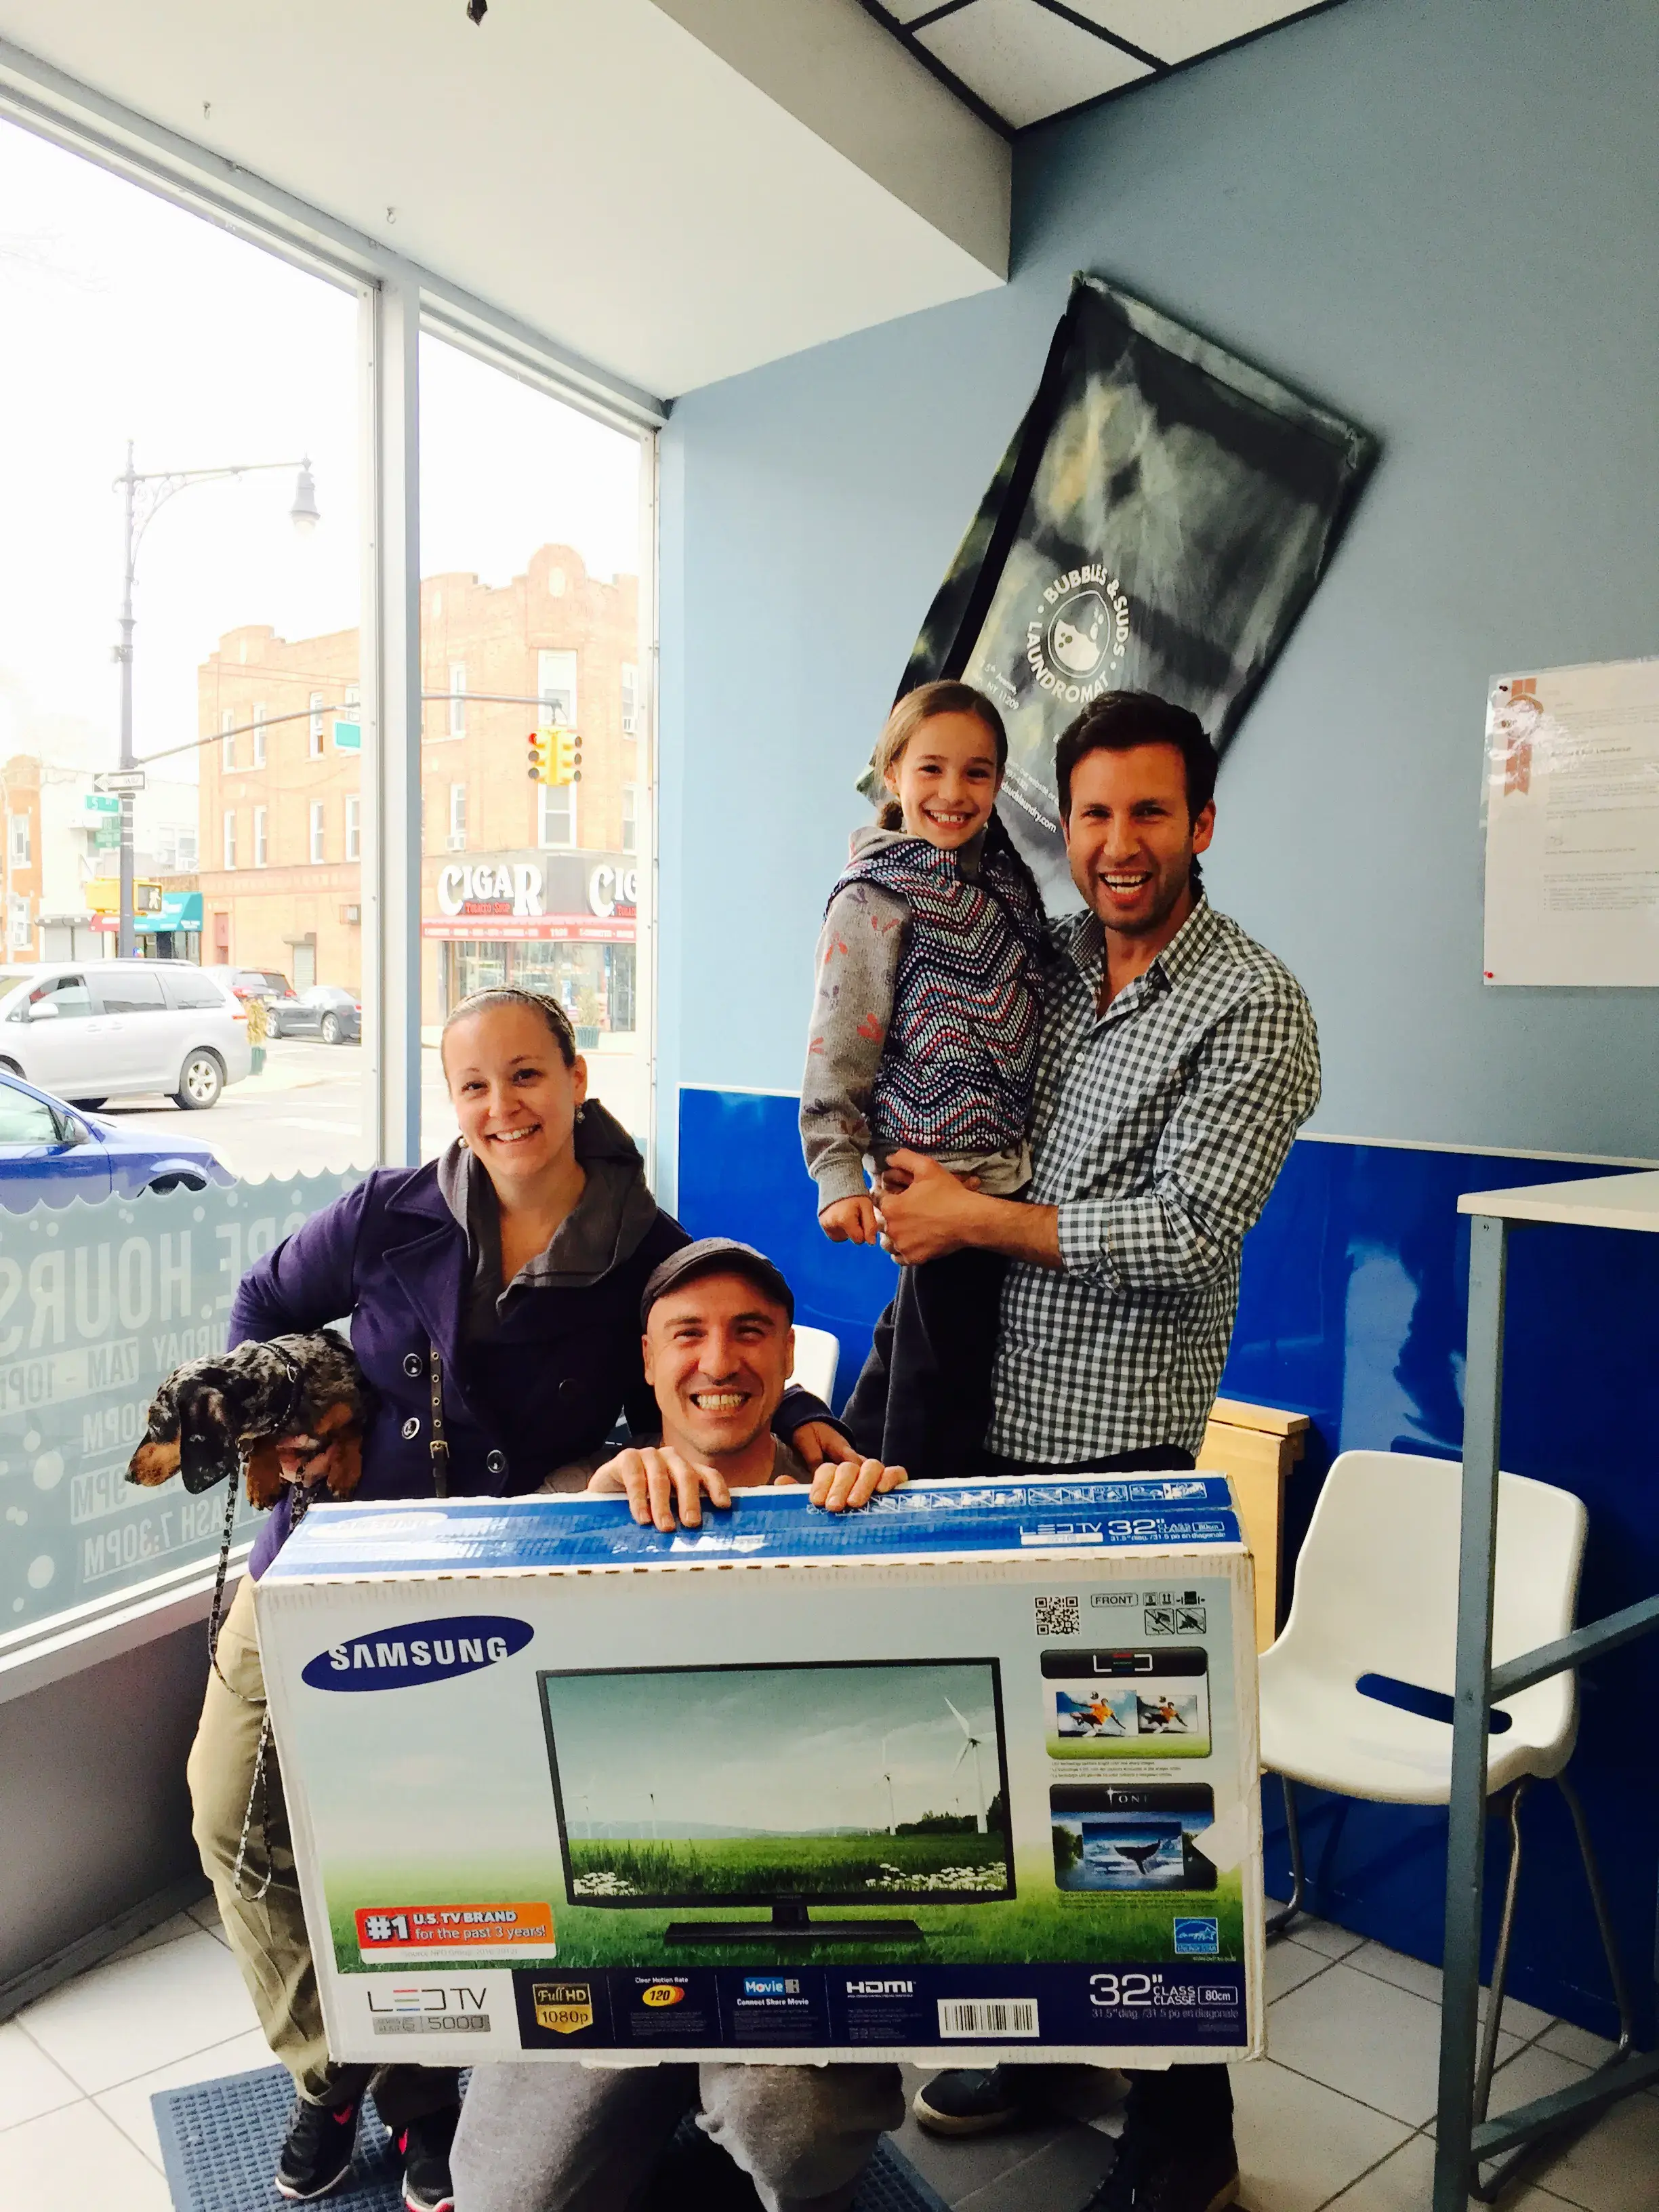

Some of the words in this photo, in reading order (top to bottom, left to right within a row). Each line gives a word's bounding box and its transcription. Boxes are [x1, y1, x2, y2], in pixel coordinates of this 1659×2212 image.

[1042, 564, 1108, 605] BUBBLES
[1106, 579, 1120, 601] &
[1113, 595, 1130, 657] SUDS
[1026, 621, 1109, 703] LAUNDROMAT
[987, 681, 998, 695] NY
[437, 863, 543, 917] CIGAR
[1076, 1521, 1103, 1533] TV
[1107, 1518, 1165, 1536] 32"
[1095, 1595, 1134, 1605] FRONT
[328, 1636, 509, 1671] SAMSUNG
[365, 1914, 410, 1942] #1
[441, 1912, 462, 1924] TV
[461, 1910, 517, 1923] BRAND
[415, 1928, 434, 1940] for
[438, 1927, 460, 1940] the
[463, 1927, 493, 1942] past
[495, 1926, 504, 1937] 3
[506, 1925, 548, 1940] years!
[537, 1988, 565, 2002] Full
[565, 1990, 587, 2002] HD
[745, 1980, 783, 1993] Movie
[846, 1980, 914, 1994] HDMI
[1089, 1973, 1163, 2006] 32"
[1153, 1986, 1195, 1996] CLASS
[1205, 1990, 1231, 2001] 80cm
[449, 1988, 487, 2011] TV
[650, 1990, 670, 2001] 120
[737, 1998, 765, 2006] Connect
[766, 1998, 786, 2006] Share
[1153, 1995, 1196, 2005] CLASSE
[541, 2010, 588, 2025] 1080p
